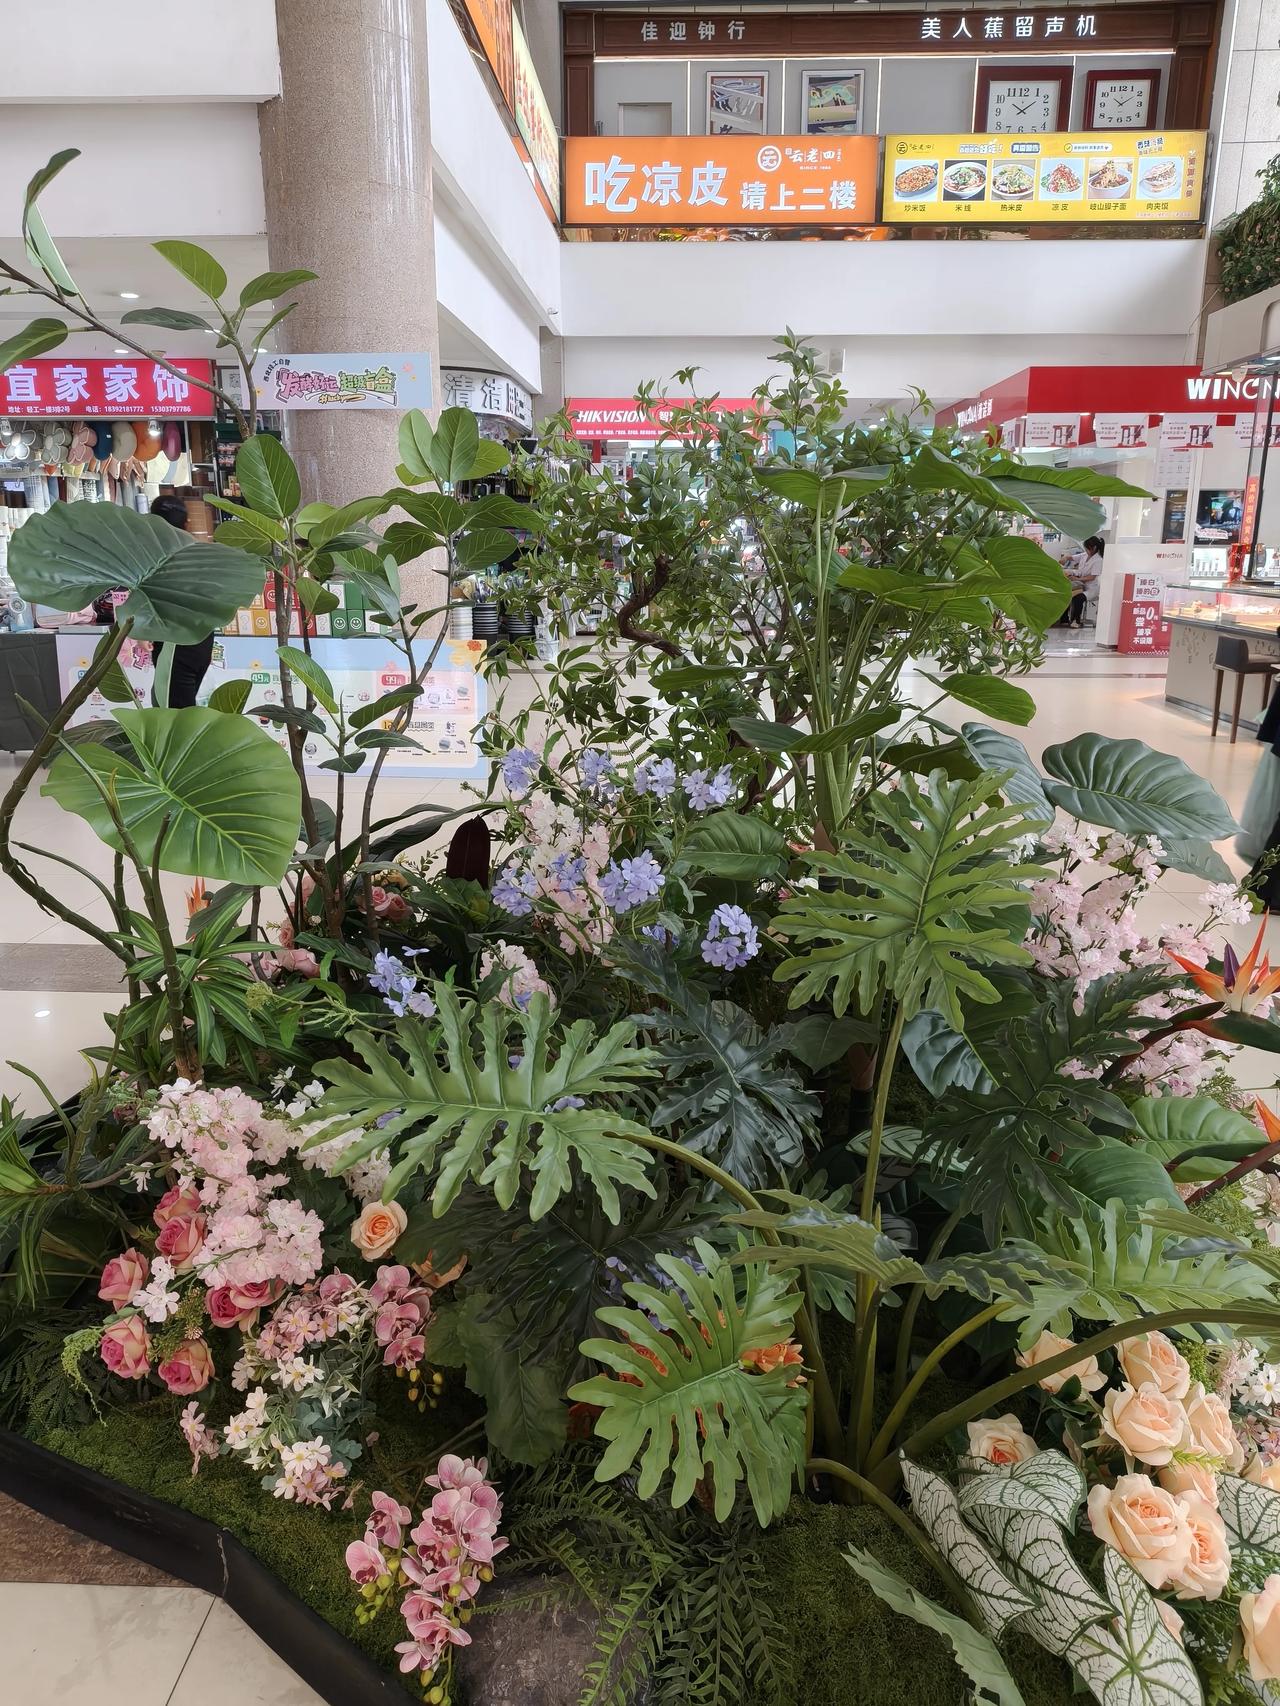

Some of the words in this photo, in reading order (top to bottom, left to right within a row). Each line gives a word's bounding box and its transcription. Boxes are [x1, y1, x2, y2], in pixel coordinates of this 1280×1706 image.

[641, 20, 746, 41] 佳迎钟行
[921, 14, 1097, 39] 美人蕉留声机
[1007, 88, 1016, 97] 11
[1018, 88, 1029, 97] 12
[1035, 88, 1040, 97] 1
[996, 95, 1005, 103] 10
[1043, 95, 1050, 103] 2
[995, 108, 1001, 117] 9
[1043, 108, 1050, 117] 3
[995, 122, 1002, 130] 8
[1040, 121, 1047, 130] 4
[585, 155, 728, 213] 吃凉皮
[740, 180, 857, 211] 请上二楼
[904, 203, 926, 212] 炒米饭
[4, 364, 189, 402] 宜家家饰
[576, 410, 647, 423] HIKVISION
